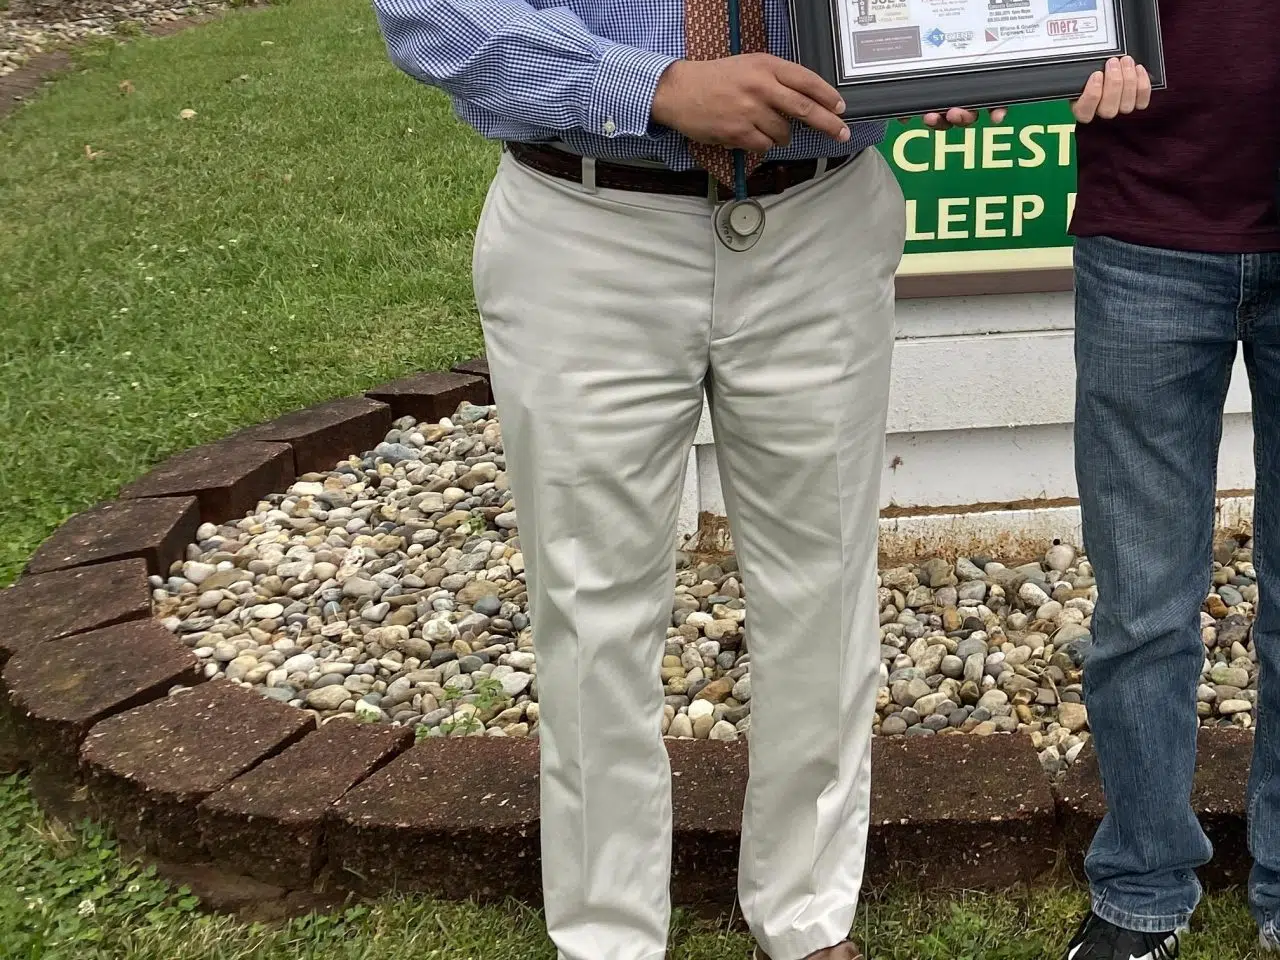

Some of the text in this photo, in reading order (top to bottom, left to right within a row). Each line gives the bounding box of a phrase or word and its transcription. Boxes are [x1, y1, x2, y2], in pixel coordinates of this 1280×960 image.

[1050, 19, 1079, 34] merz
[892, 123, 1075, 172] CHEST
[905, 194, 1045, 240] LEEP
